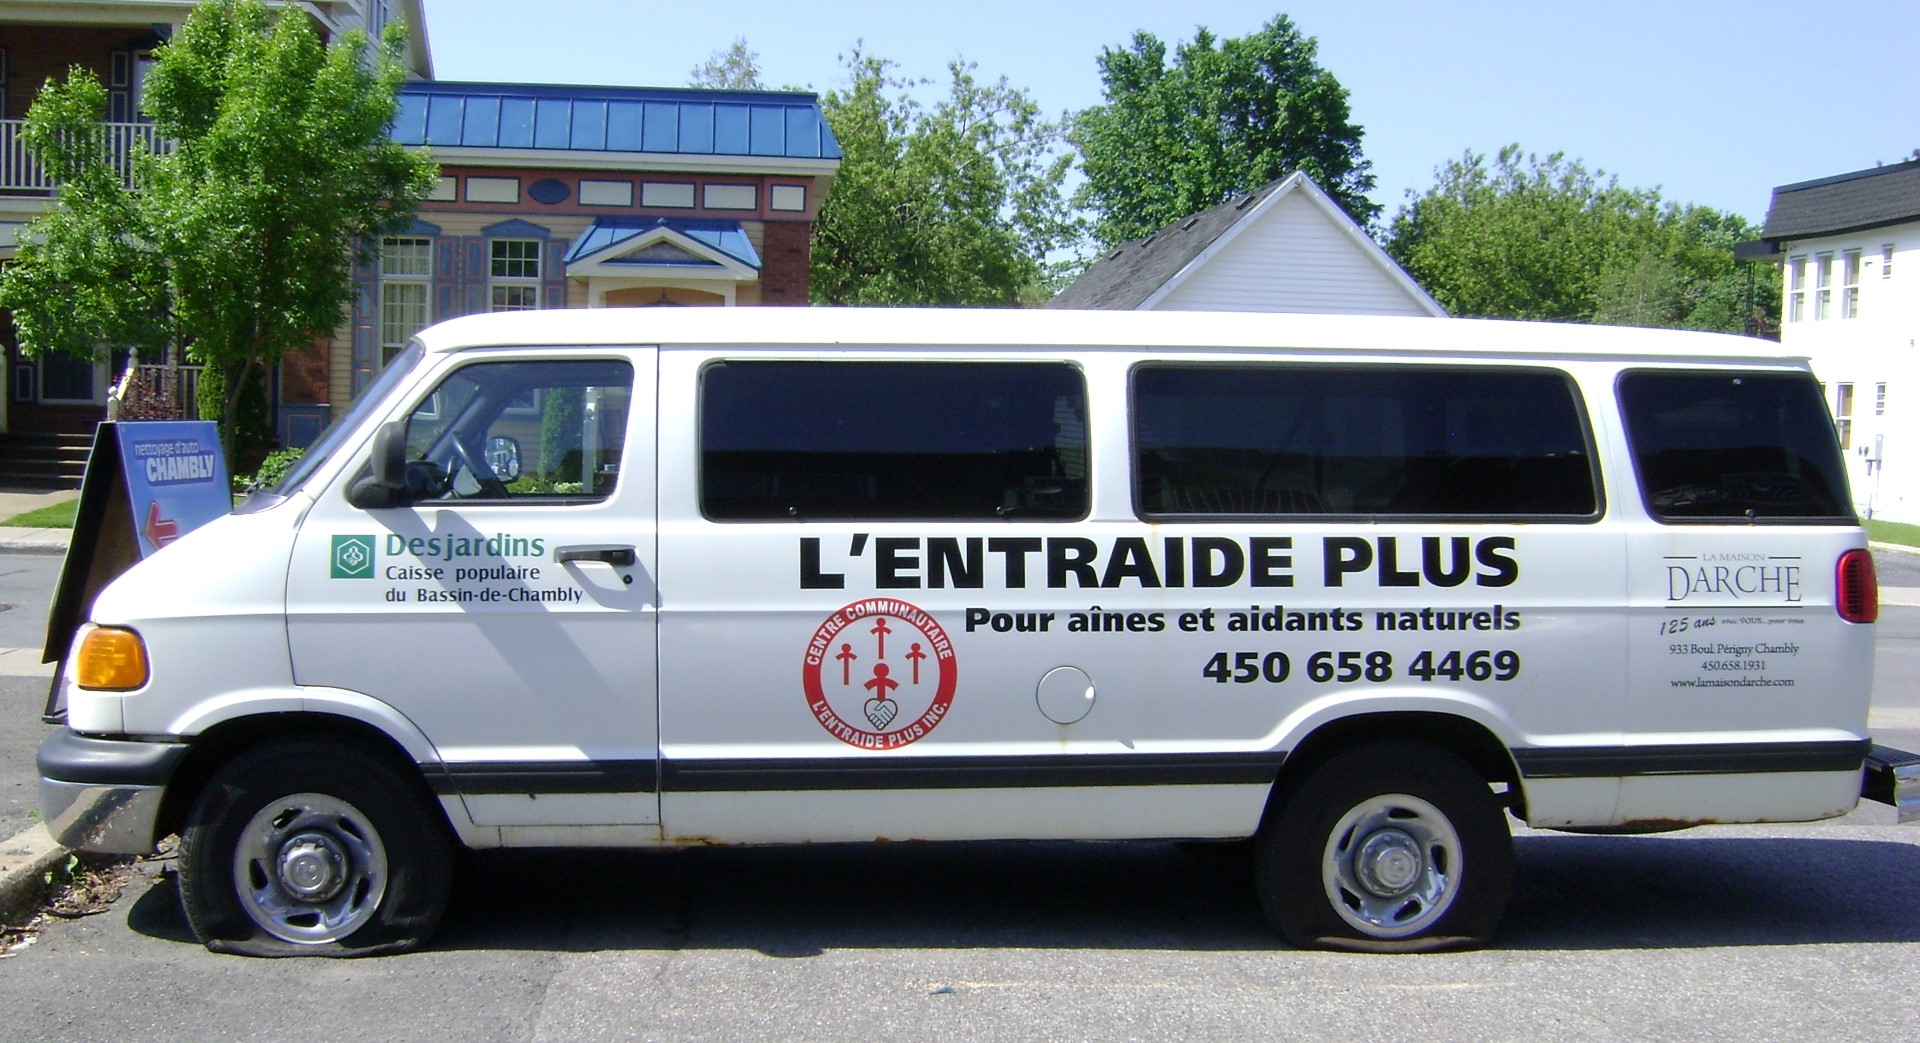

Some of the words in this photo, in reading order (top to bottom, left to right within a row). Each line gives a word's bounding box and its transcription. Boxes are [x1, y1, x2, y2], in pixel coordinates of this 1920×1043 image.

[135, 442, 173, 457] nettoyage
[146, 454, 215, 482] CHAMBLY
[386, 533, 545, 561] Desjardins
[1703, 553, 1716, 561] LA
[1719, 553, 1765, 561] MAISON
[800, 533, 1293, 589] L'ENTRAIDE
[1323, 536, 1519, 588] PLUS
[386, 565, 444, 580] Caisse
[456, 565, 541, 582] populaire
[1666, 565, 1802, 602] DARCHE
[386, 588, 406, 602] du
[417, 587, 583, 604] Bassin-de-Chambly
[965, 607, 1055, 632] Pour
[1178, 607, 1215, 632] et
[1227, 605, 1363, 632] aidants
[1376, 604, 1520, 631] naturels
[1660, 617, 1688, 636] 125
[1693, 616, 1717, 629] ans
[807, 614, 845, 666] CENTRE
[845, 600, 953, 660] COMMUNAUTAIRE
[1669, 644, 1688, 654] 933
[1717, 643, 1753, 658] Périgny
[1755, 643, 1799, 656] Chambly
[1203, 651, 1290, 683] 450
[1306, 651, 1393, 683] 658
[1408, 650, 1520, 682] 4469
[1701, 660, 1766, 671] 450.658.1931
[1671, 676, 1795, 687] www.lamaisondarche.com
[812, 700, 884, 748] L'ENTRAIDE
[888, 724, 924, 747] PLUS
[922, 702, 949, 728] INC.
